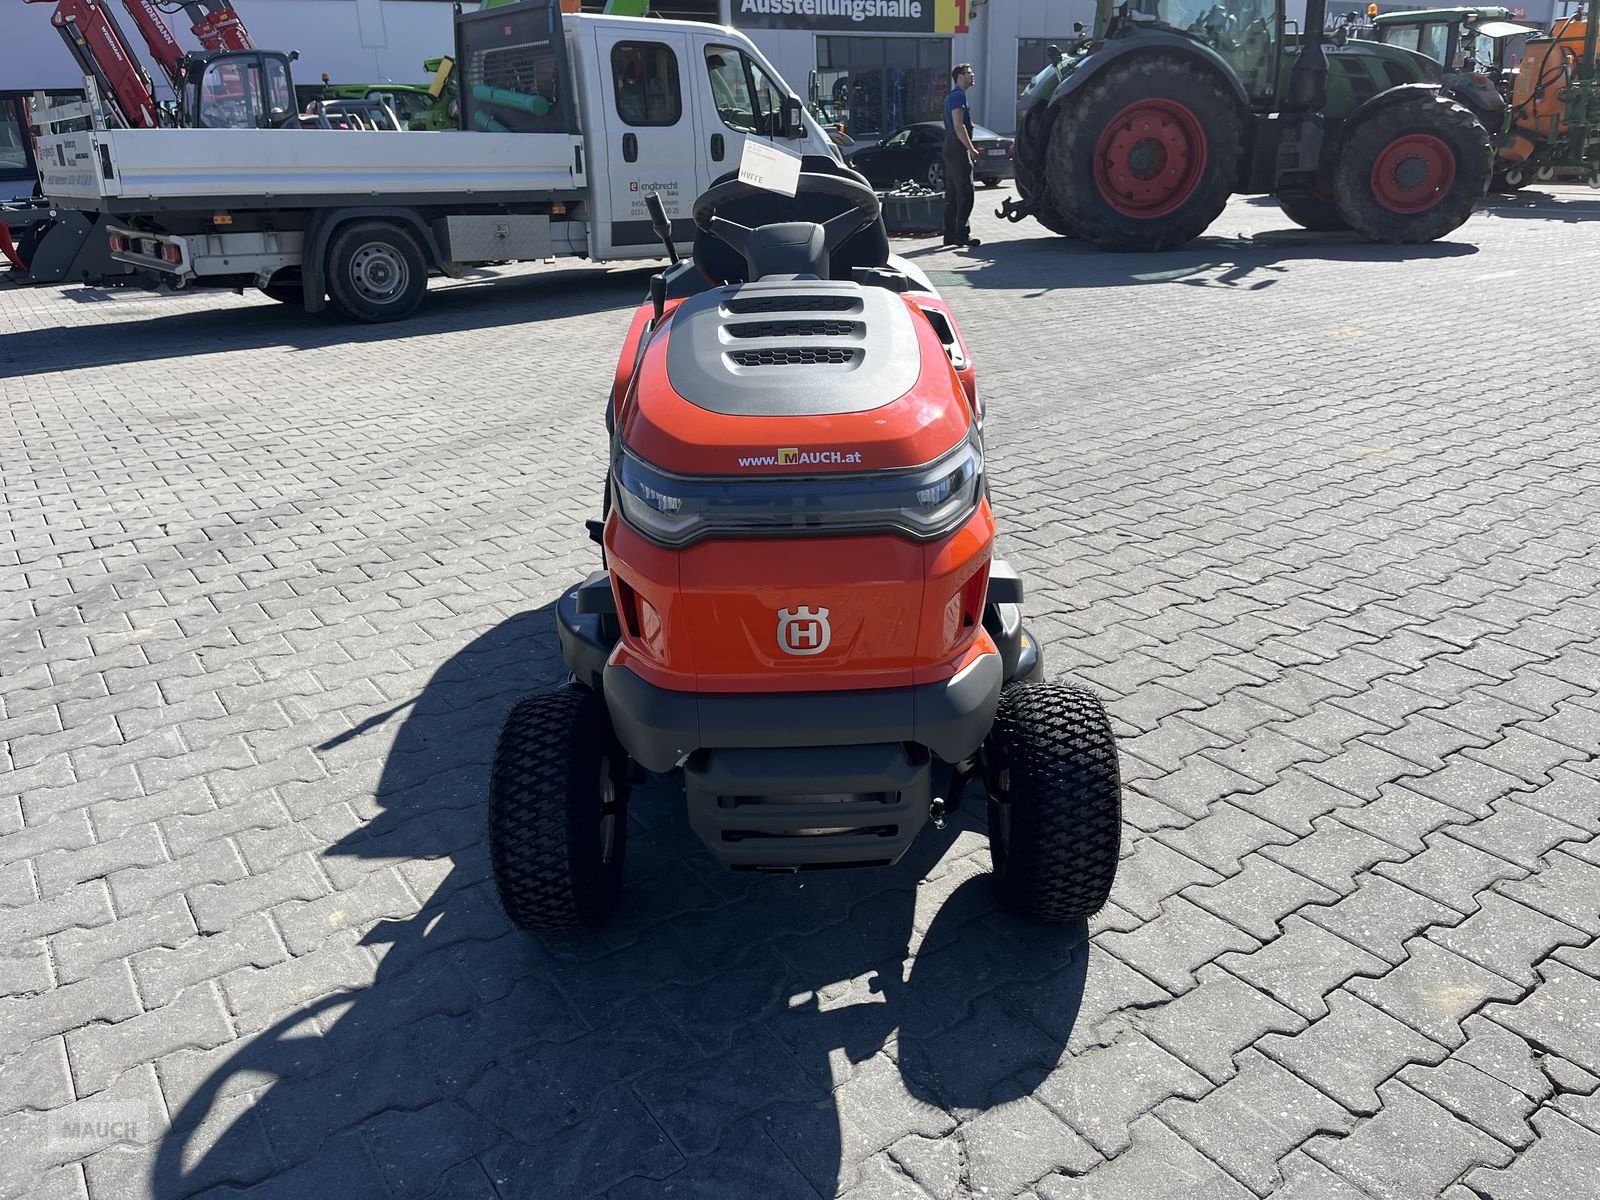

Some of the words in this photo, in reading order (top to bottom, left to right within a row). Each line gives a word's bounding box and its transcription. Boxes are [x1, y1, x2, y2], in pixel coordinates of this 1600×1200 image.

[741, 0, 921, 21] Ausstellungshalle
[141, 0, 173, 45] EIDEMANN
[101, 26, 123, 62] WEIDEMANN
[641, 181, 678, 191] englbrecht
[738, 450, 862, 467] www.MAUCH.at
